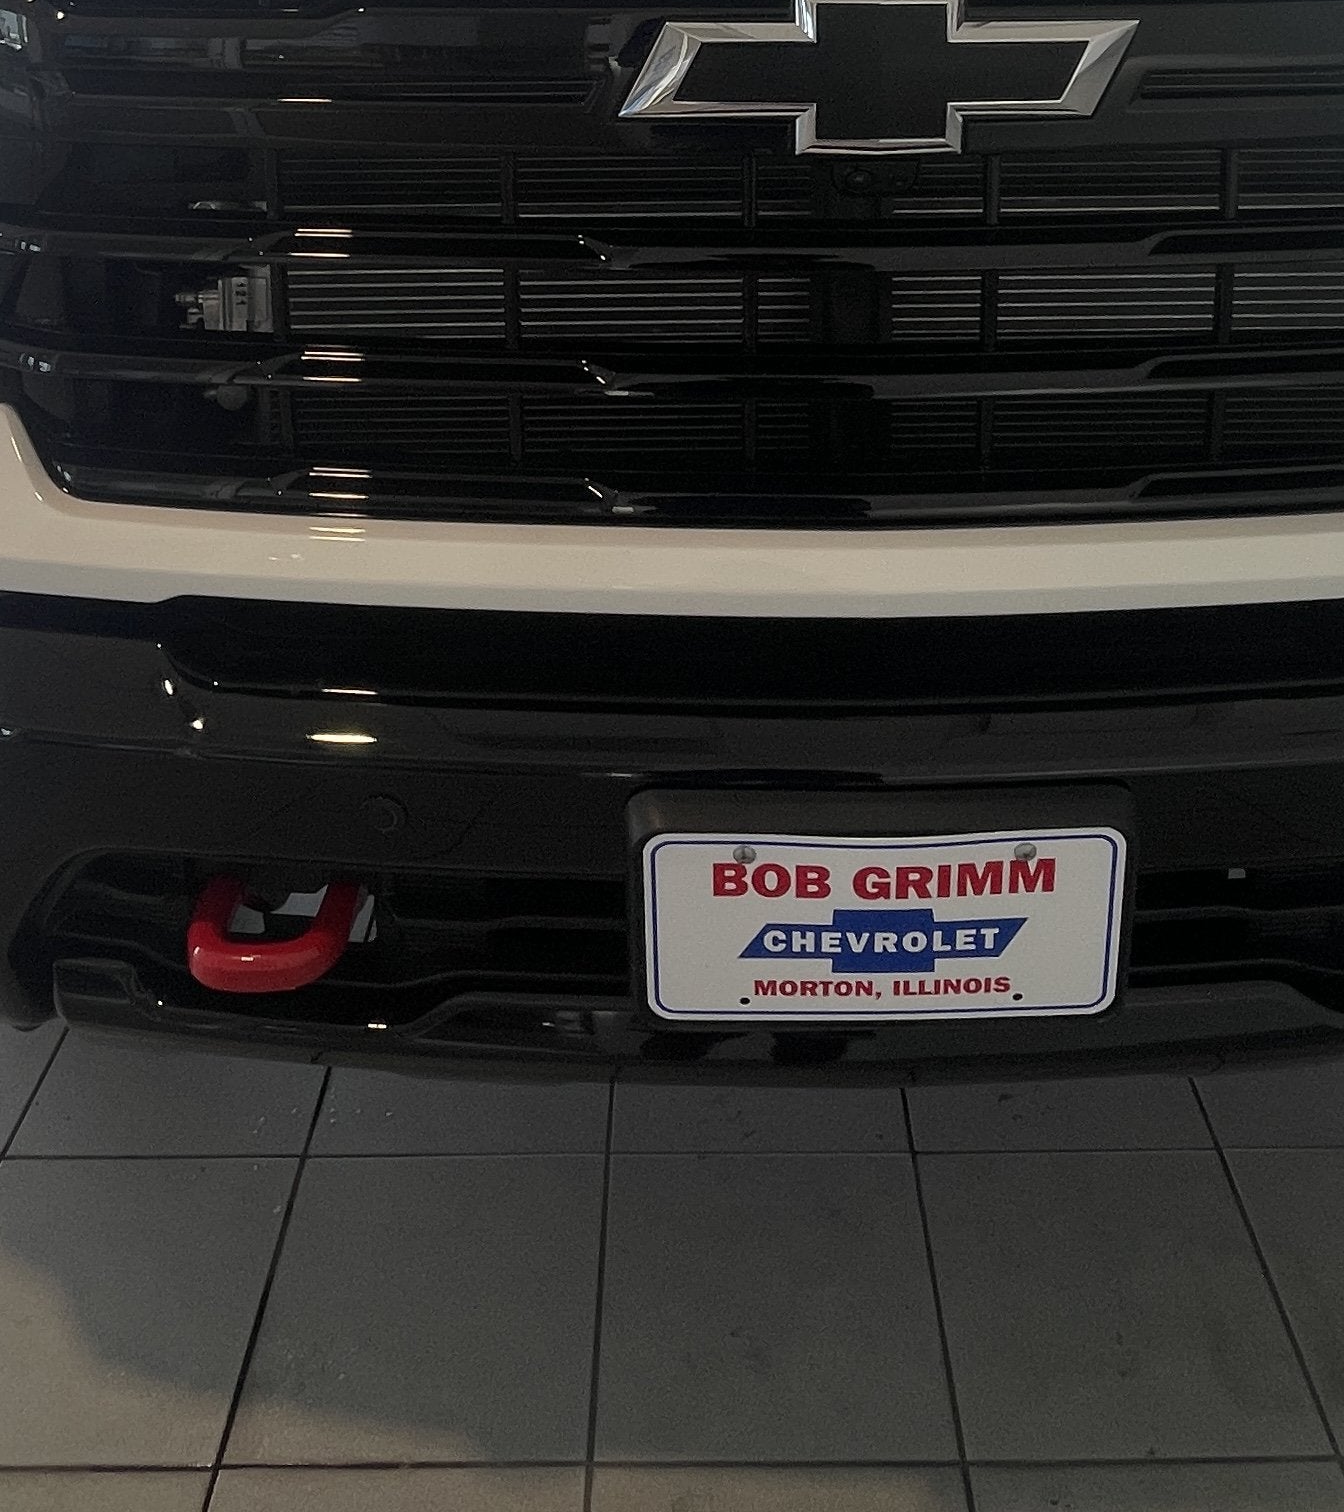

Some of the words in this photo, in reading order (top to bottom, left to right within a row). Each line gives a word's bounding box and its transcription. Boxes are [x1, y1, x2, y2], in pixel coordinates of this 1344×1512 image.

[712, 862, 833, 899] BOB
[852, 858, 1057, 900] GRIMM
[762, 928, 1001, 953] CHEVROLET
[754, 979, 883, 1000] MORTON,
[893, 976, 1012, 997] ILLINOIS
